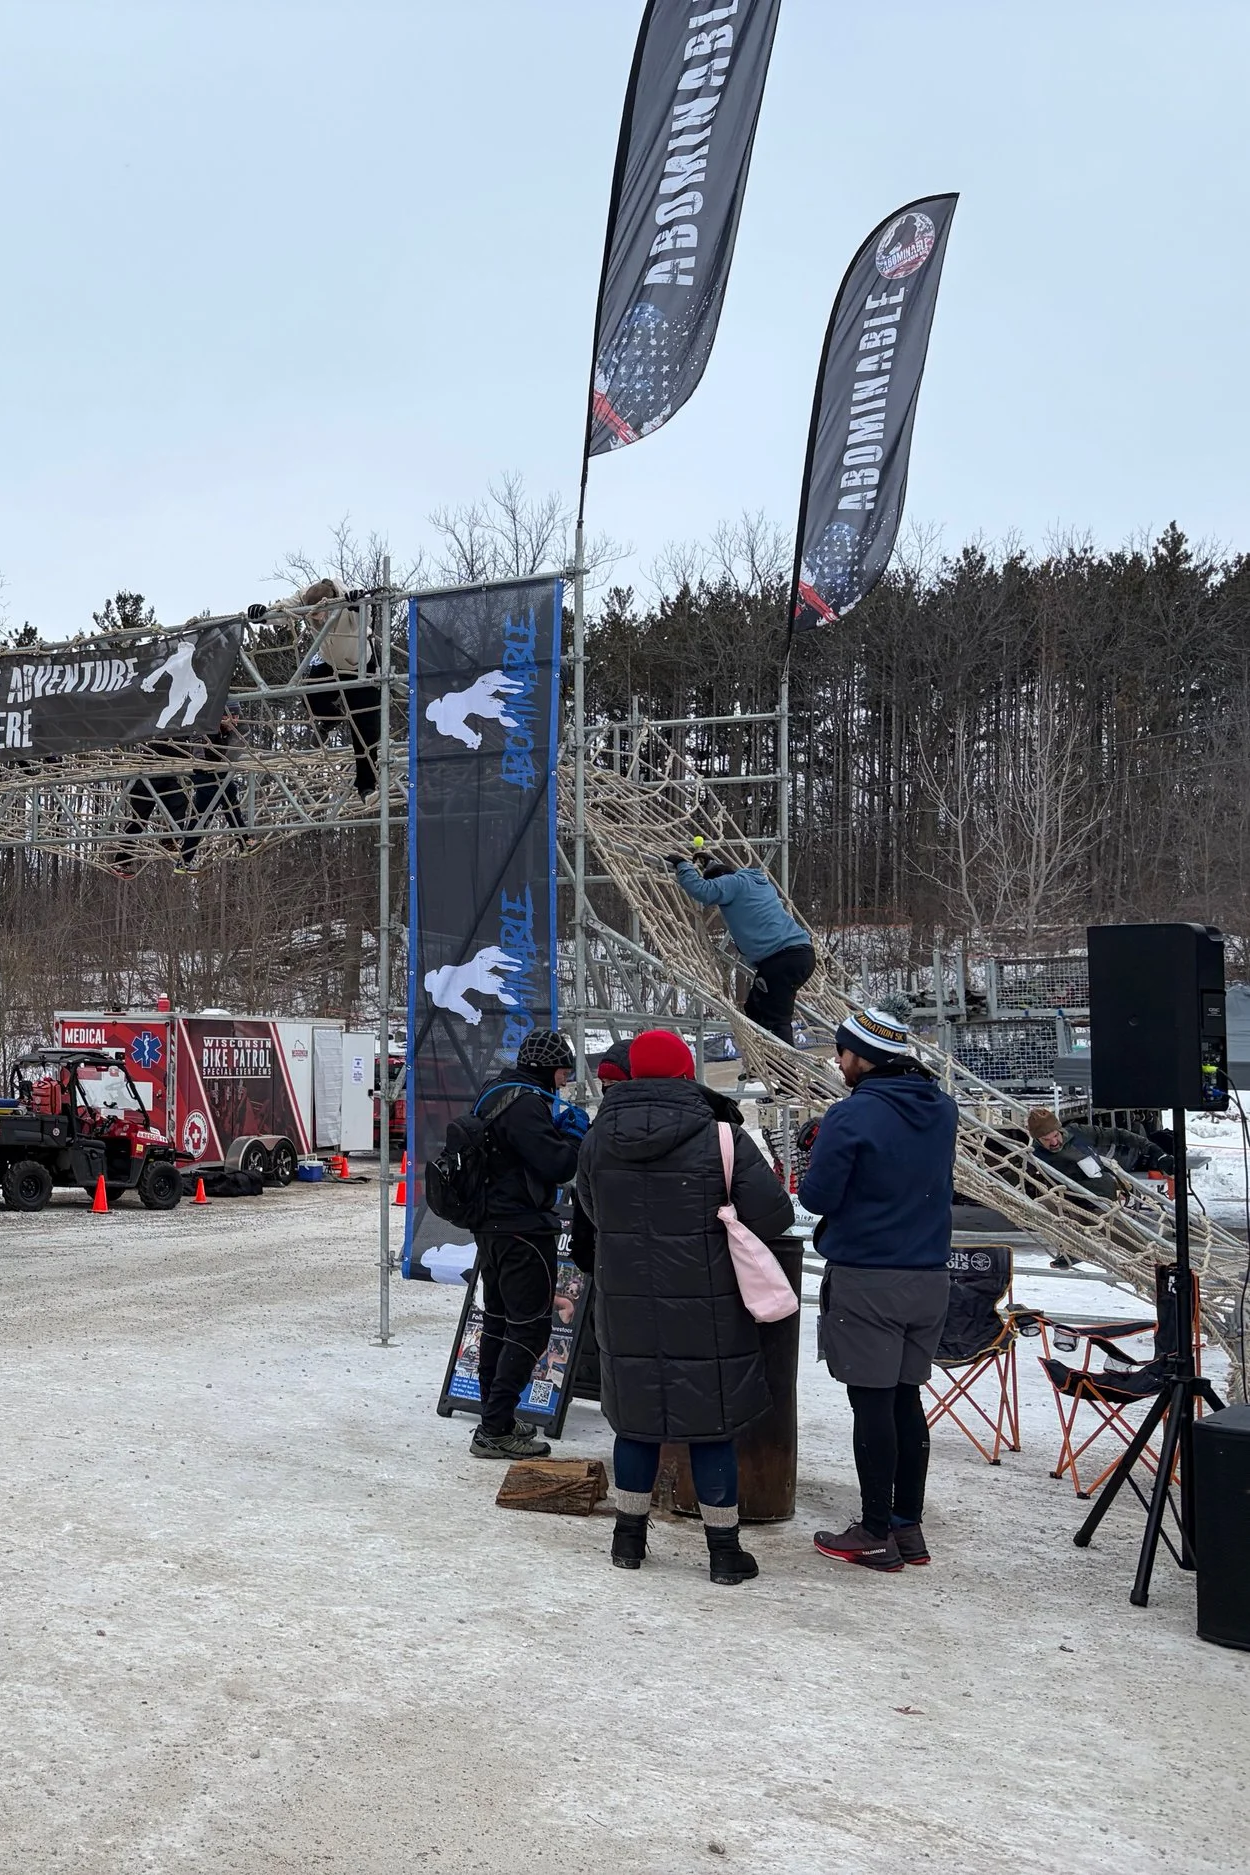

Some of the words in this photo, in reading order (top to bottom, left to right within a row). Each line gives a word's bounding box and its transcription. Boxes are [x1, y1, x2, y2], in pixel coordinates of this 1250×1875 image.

[644, 0, 739, 286] ABOMINABL
[838, 286, 905, 511] ABOMINABLE
[7, 657, 138, 704] ADVENTURE
[64, 1027, 108, 1044] MEDICAL
[860, 1016, 894, 1040] MARATHON
[203, 1039, 272, 1048] WISCONSIN
[203, 1048, 228, 1067] BIKE
[233, 1048, 272, 1067] PATROL
[202, 1067, 232, 1076] SPECIAL
[235, 1067, 255, 1076] EVENT
[258, 1068, 272, 1076] EMS
